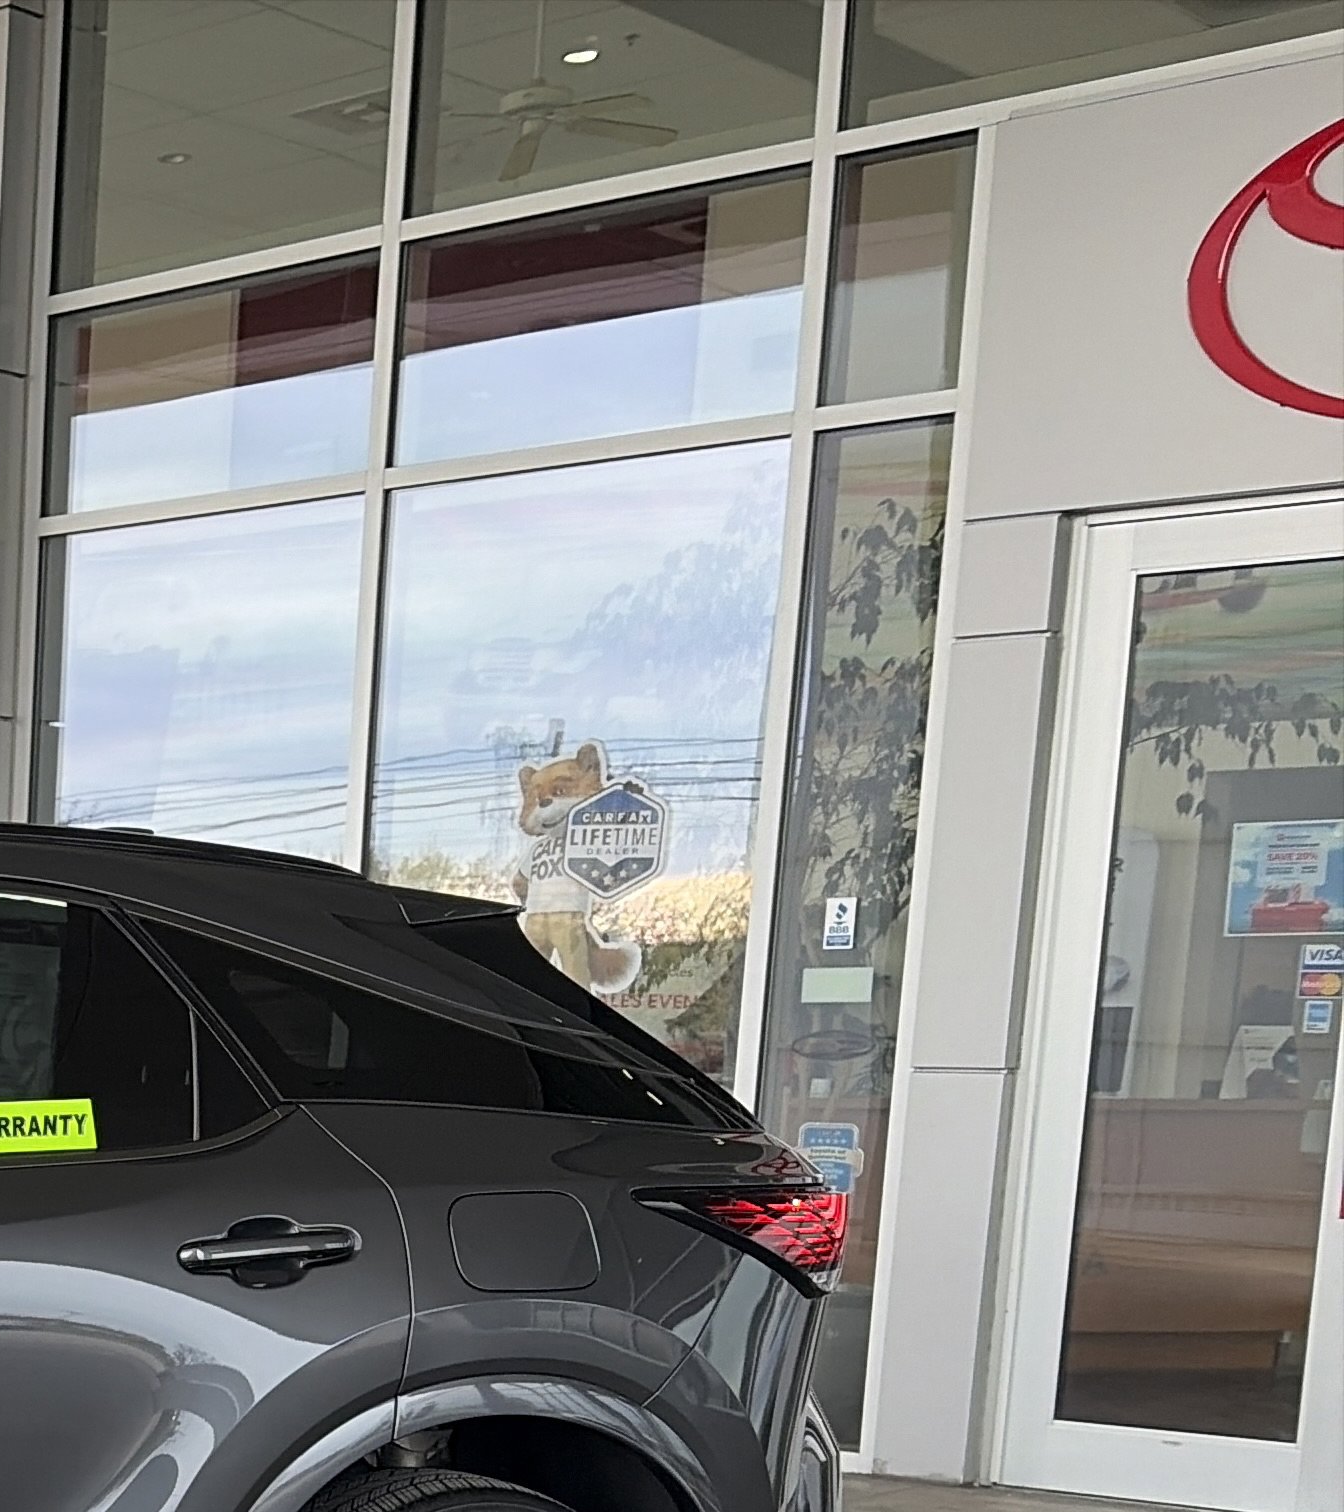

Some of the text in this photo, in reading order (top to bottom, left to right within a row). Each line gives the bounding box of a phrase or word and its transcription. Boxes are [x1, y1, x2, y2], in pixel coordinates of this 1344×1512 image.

[582, 810, 651, 823] CARFAX
[570, 827, 658, 846] LIFETIME
[530, 857, 563, 882] FOX
[1310, 948, 1344, 962] VISA
